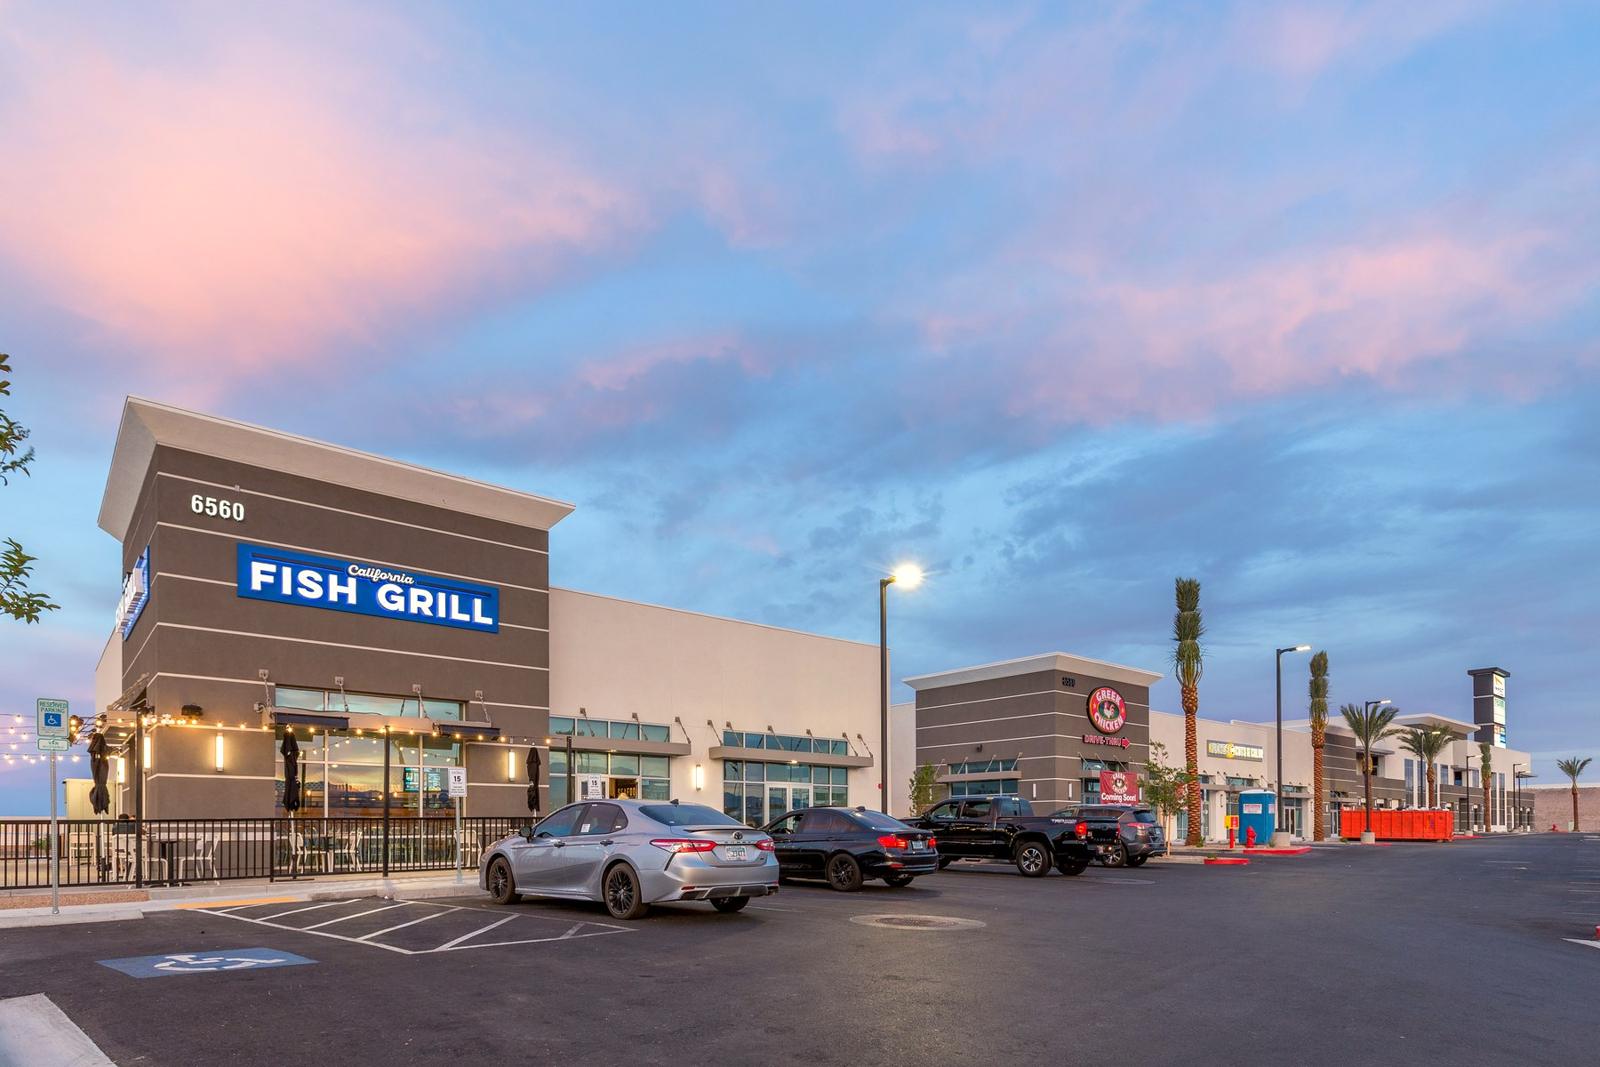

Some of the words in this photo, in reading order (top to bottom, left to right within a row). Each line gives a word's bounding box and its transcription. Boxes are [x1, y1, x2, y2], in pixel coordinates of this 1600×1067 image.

[191, 494, 245, 521] 6560
[347, 564, 414, 585] California
[250, 561, 357, 604] FISH
[377, 584, 493, 625] GRILL
[1095, 689, 1122, 706] GREEK
[1094, 712, 1124, 730] CHICKEN
[1084, 735, 1121, 747] DRIVE-THRU
[1101, 792, 1122, 802] Coming
[1122, 794, 1137, 802] Soon!
